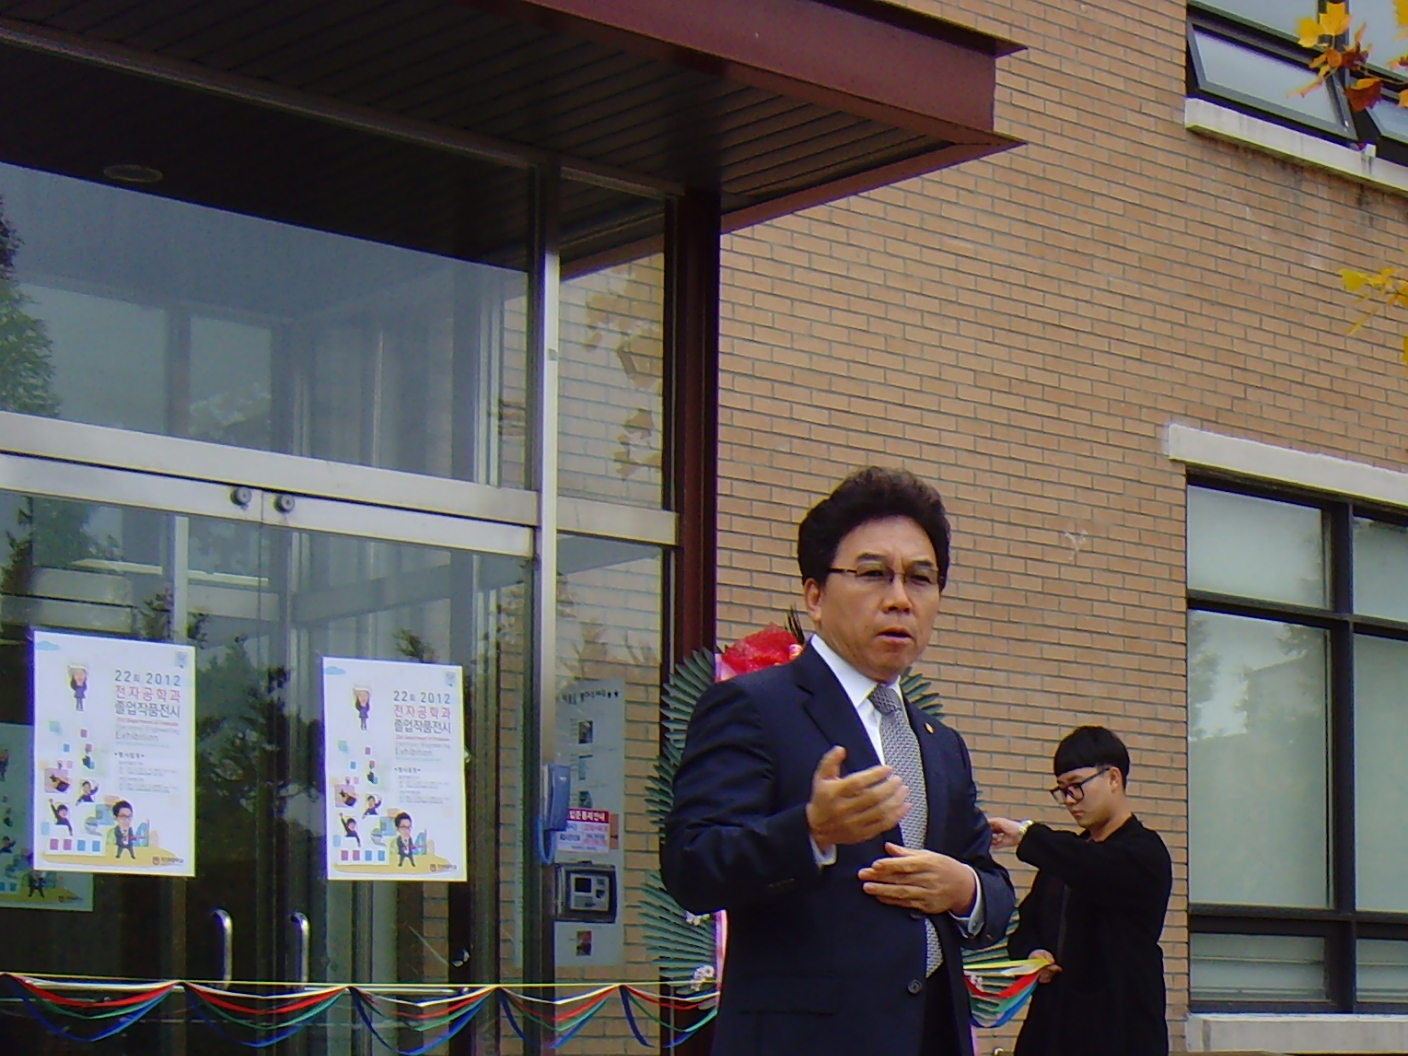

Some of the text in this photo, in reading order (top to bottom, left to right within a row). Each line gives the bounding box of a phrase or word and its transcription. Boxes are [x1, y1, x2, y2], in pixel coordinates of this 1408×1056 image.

[145, 672, 181, 687] 2012
[115, 684, 181, 703] 전자공학과
[420, 692, 451, 705] 2012
[114, 700, 181, 719] 졸업작품전시
[393, 704, 451, 720] 전자공학과
[394, 718, 451, 734] 졸업작품전시
